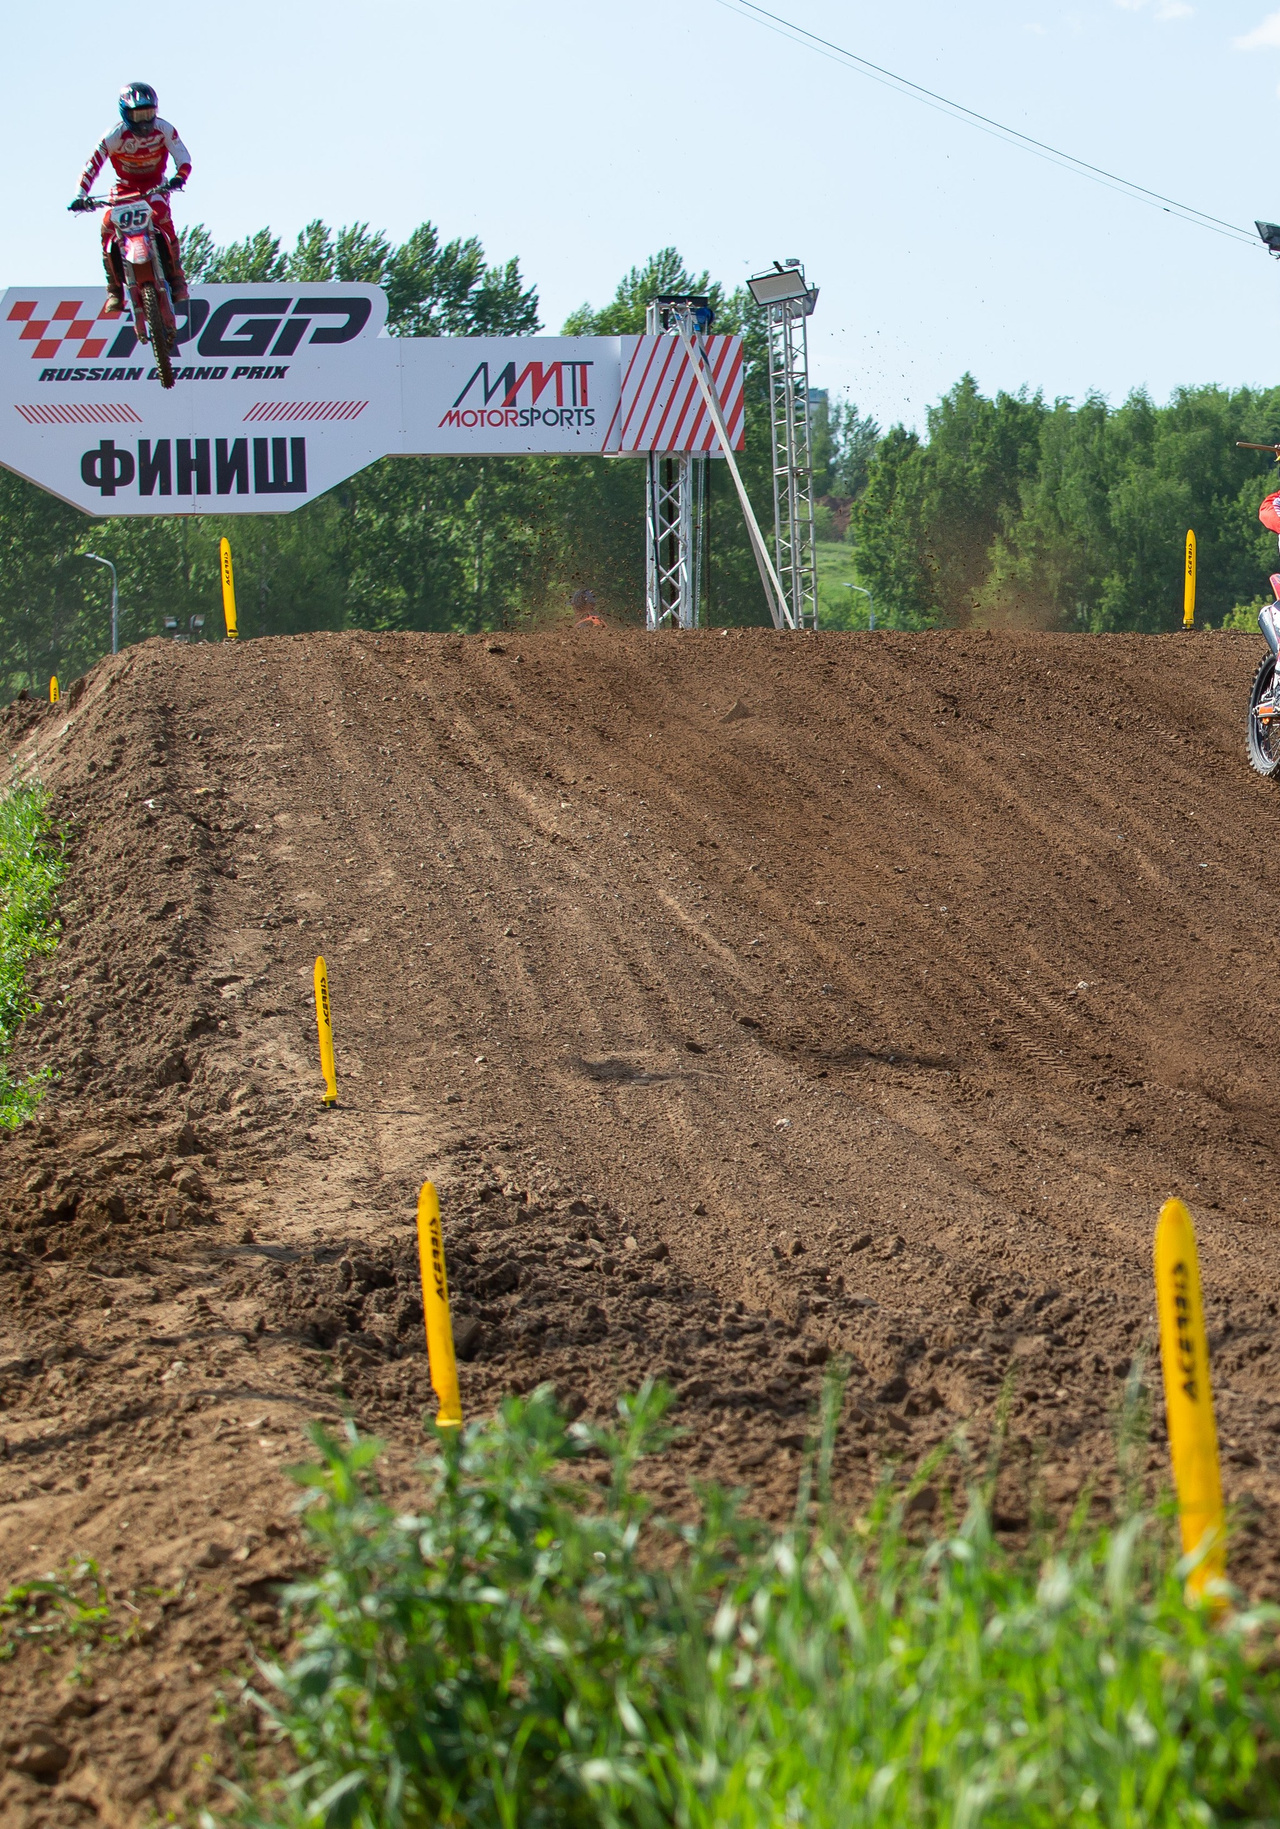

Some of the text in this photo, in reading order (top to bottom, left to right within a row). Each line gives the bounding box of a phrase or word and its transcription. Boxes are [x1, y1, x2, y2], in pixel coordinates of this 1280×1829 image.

[118, 208, 149, 229] 95
[38, 366, 144, 382] RUSSIAN
[231, 366, 290, 380] PRIX
[438, 408, 595, 428] MOTORSPORTS
[80, 437, 307, 497] ФИНИШ
